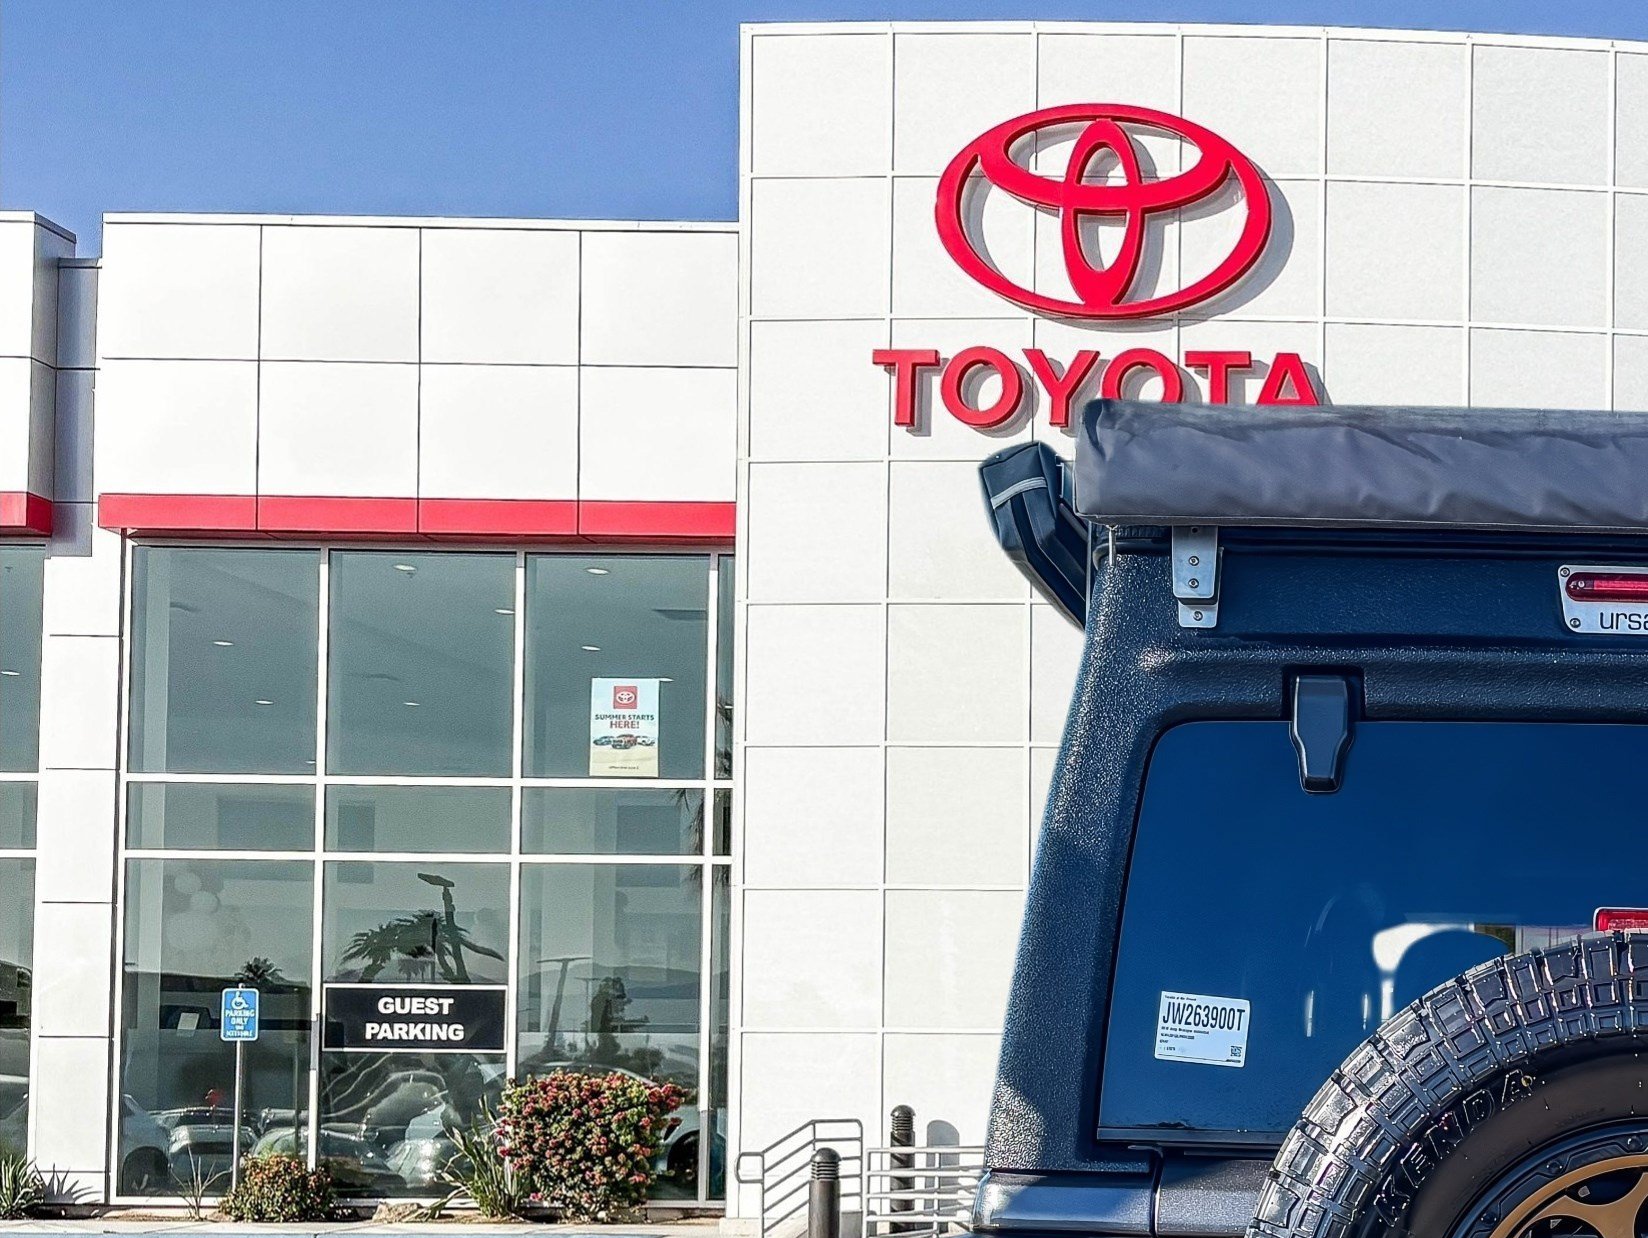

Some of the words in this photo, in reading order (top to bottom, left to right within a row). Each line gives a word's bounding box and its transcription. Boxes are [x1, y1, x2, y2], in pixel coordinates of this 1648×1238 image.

[872, 346, 1320, 427] TOYOTA
[594, 713, 626, 721] SUMMER
[609, 720, 640, 729] HERE!
[225, 1009, 255, 1017] PARKING
[377, 997, 454, 1015] GUEST
[1162, 1001, 1246, 1032] JW263900T
[365, 1022, 465, 1041] PARKING
[1373, 1067, 1533, 1228] KENDA
